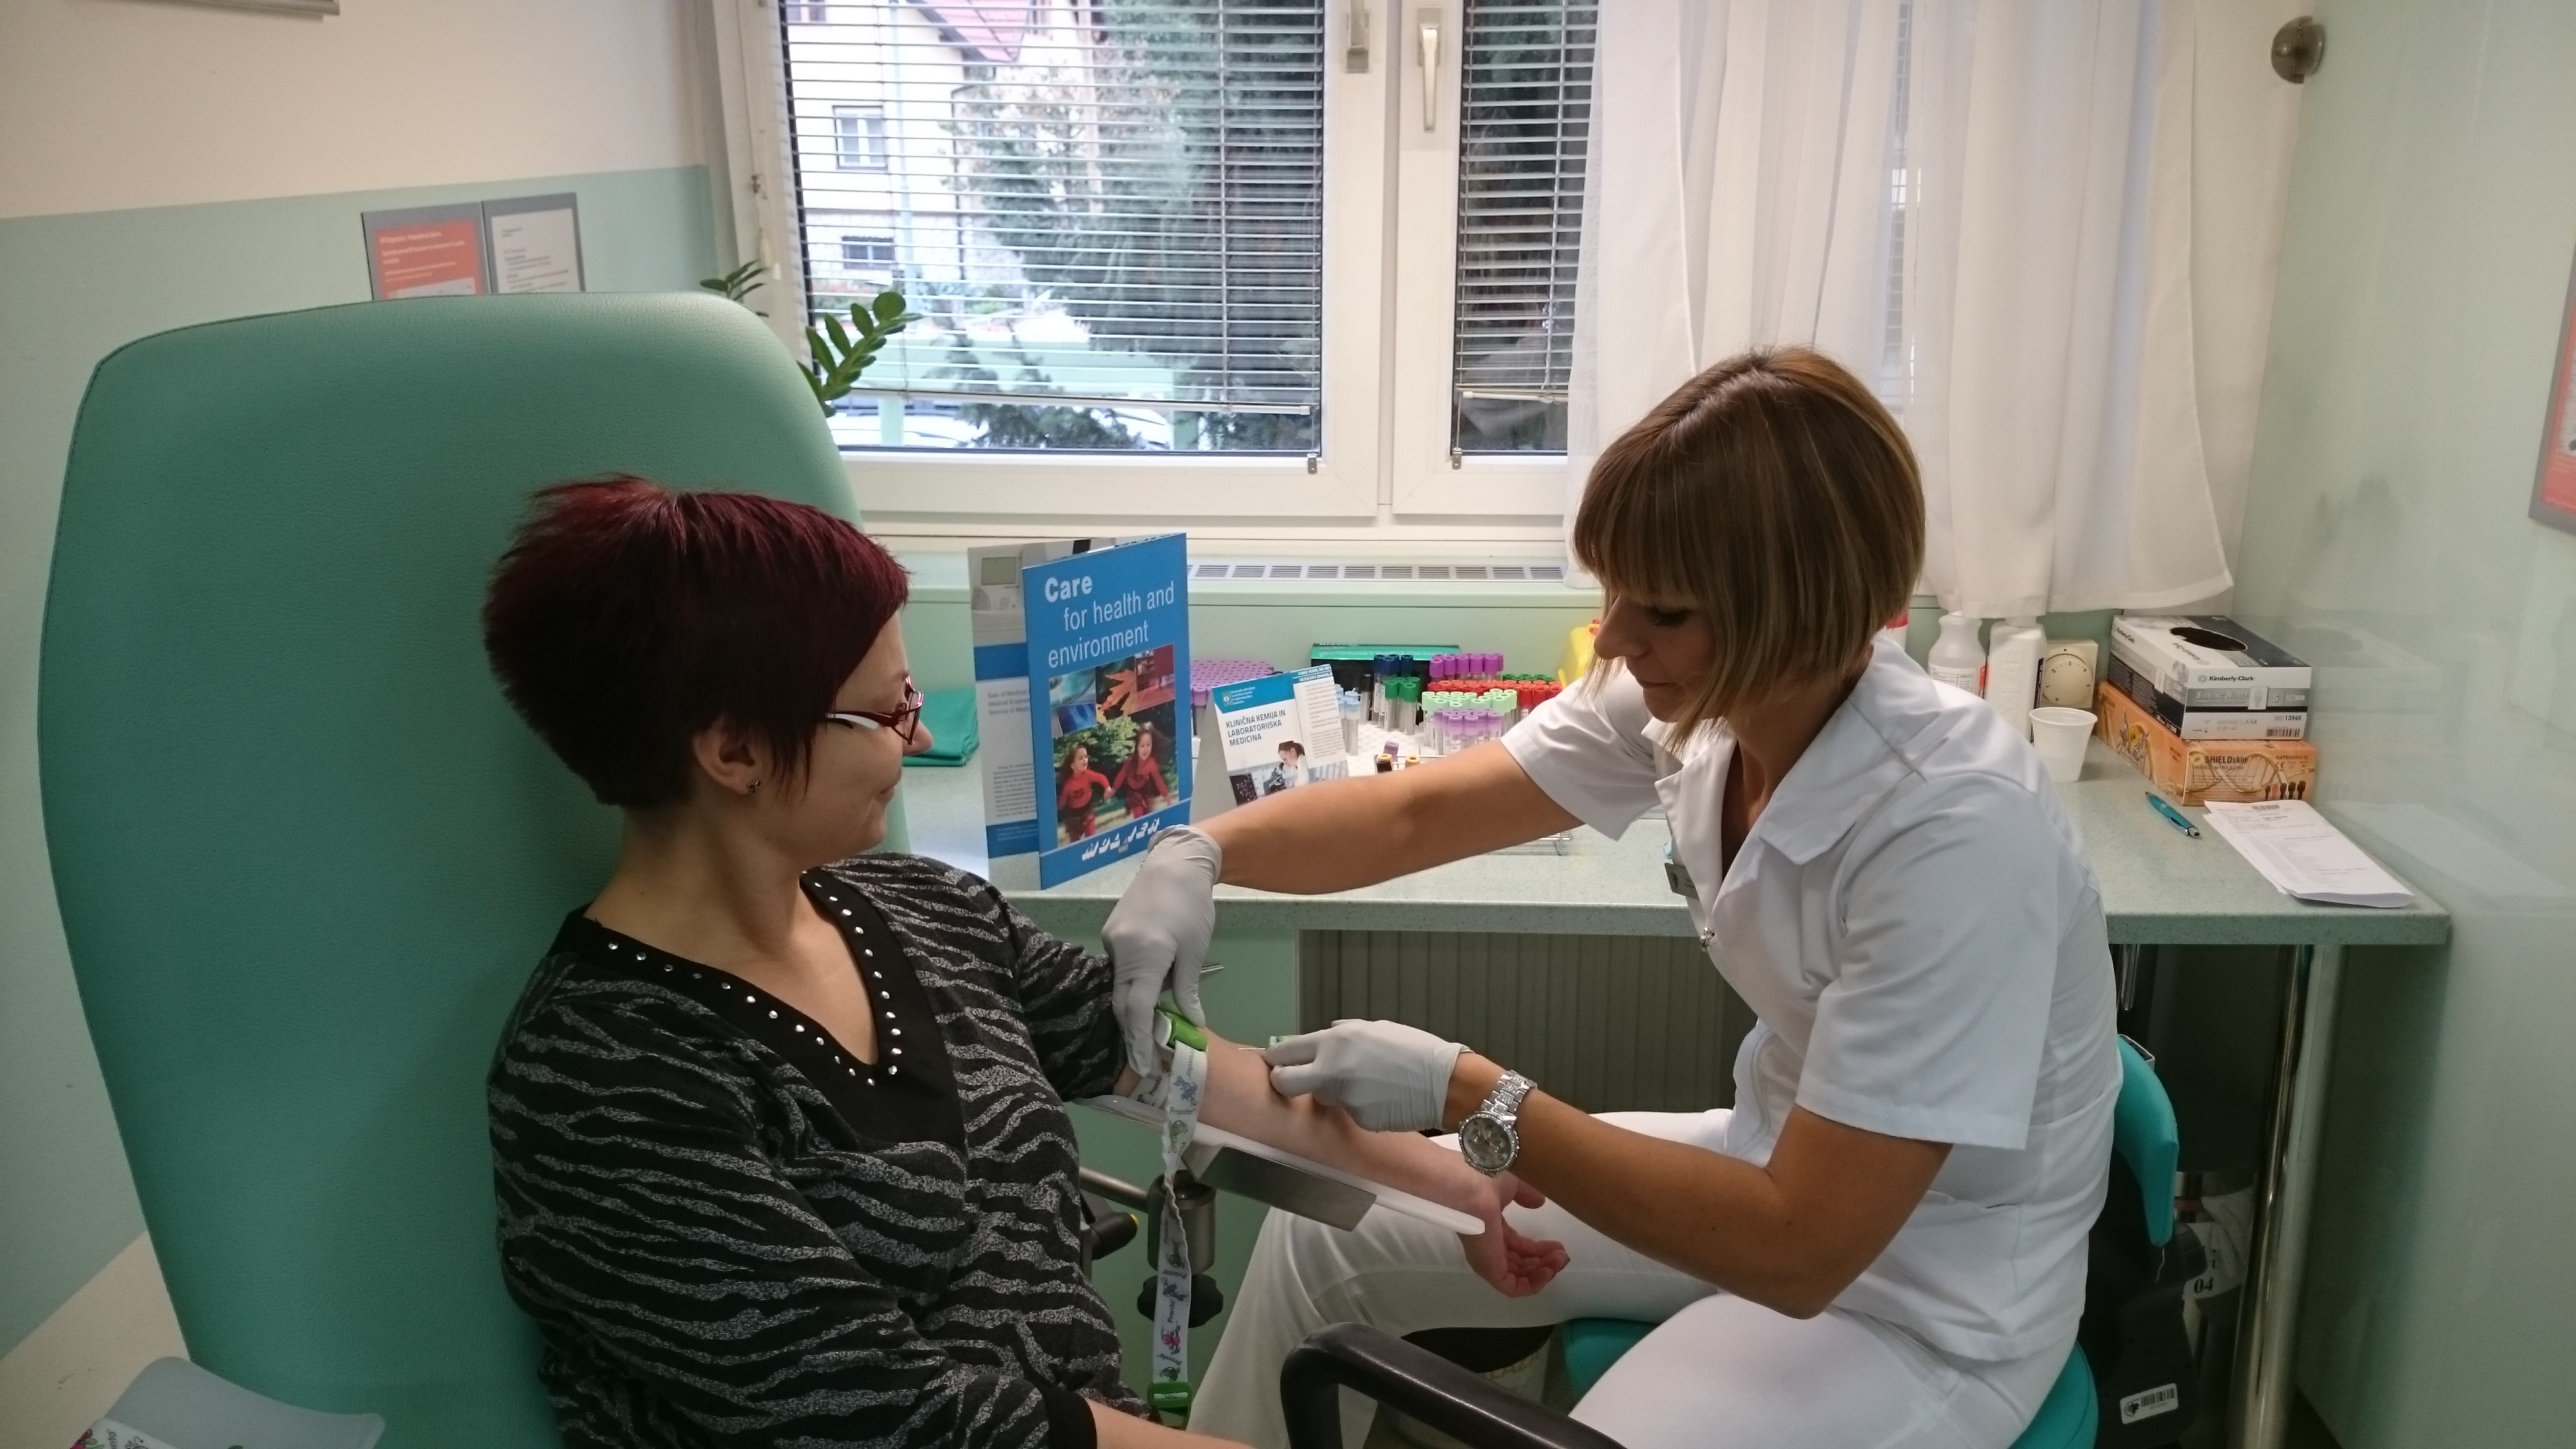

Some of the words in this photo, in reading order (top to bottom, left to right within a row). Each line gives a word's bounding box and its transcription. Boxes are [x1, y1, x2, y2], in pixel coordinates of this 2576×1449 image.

[1044, 576, 1093, 602] Care
[1064, 606, 1087, 631] for
[1093, 590, 1141, 625] health
[1146, 581, 1174, 610] and
[1049, 620, 1148, 668] environment
[2273, 694, 2279, 702] S
[1226, 716, 1255, 729] KLINIČNA
[1256, 712, 1278, 722] KEMIJA
[1227, 720, 1282, 737] LABORATORIJSKA
[1229, 734, 1262, 747] MEDICINA
[2205, 755, 2247, 763] SHIELDskin
[1170, 1107, 1193, 1115] Pronto
[2194, 1277, 2213, 1293] 04
[1167, 1300, 1175, 1323] Pronto
[1160, 1354, 1183, 1366] Pronto
